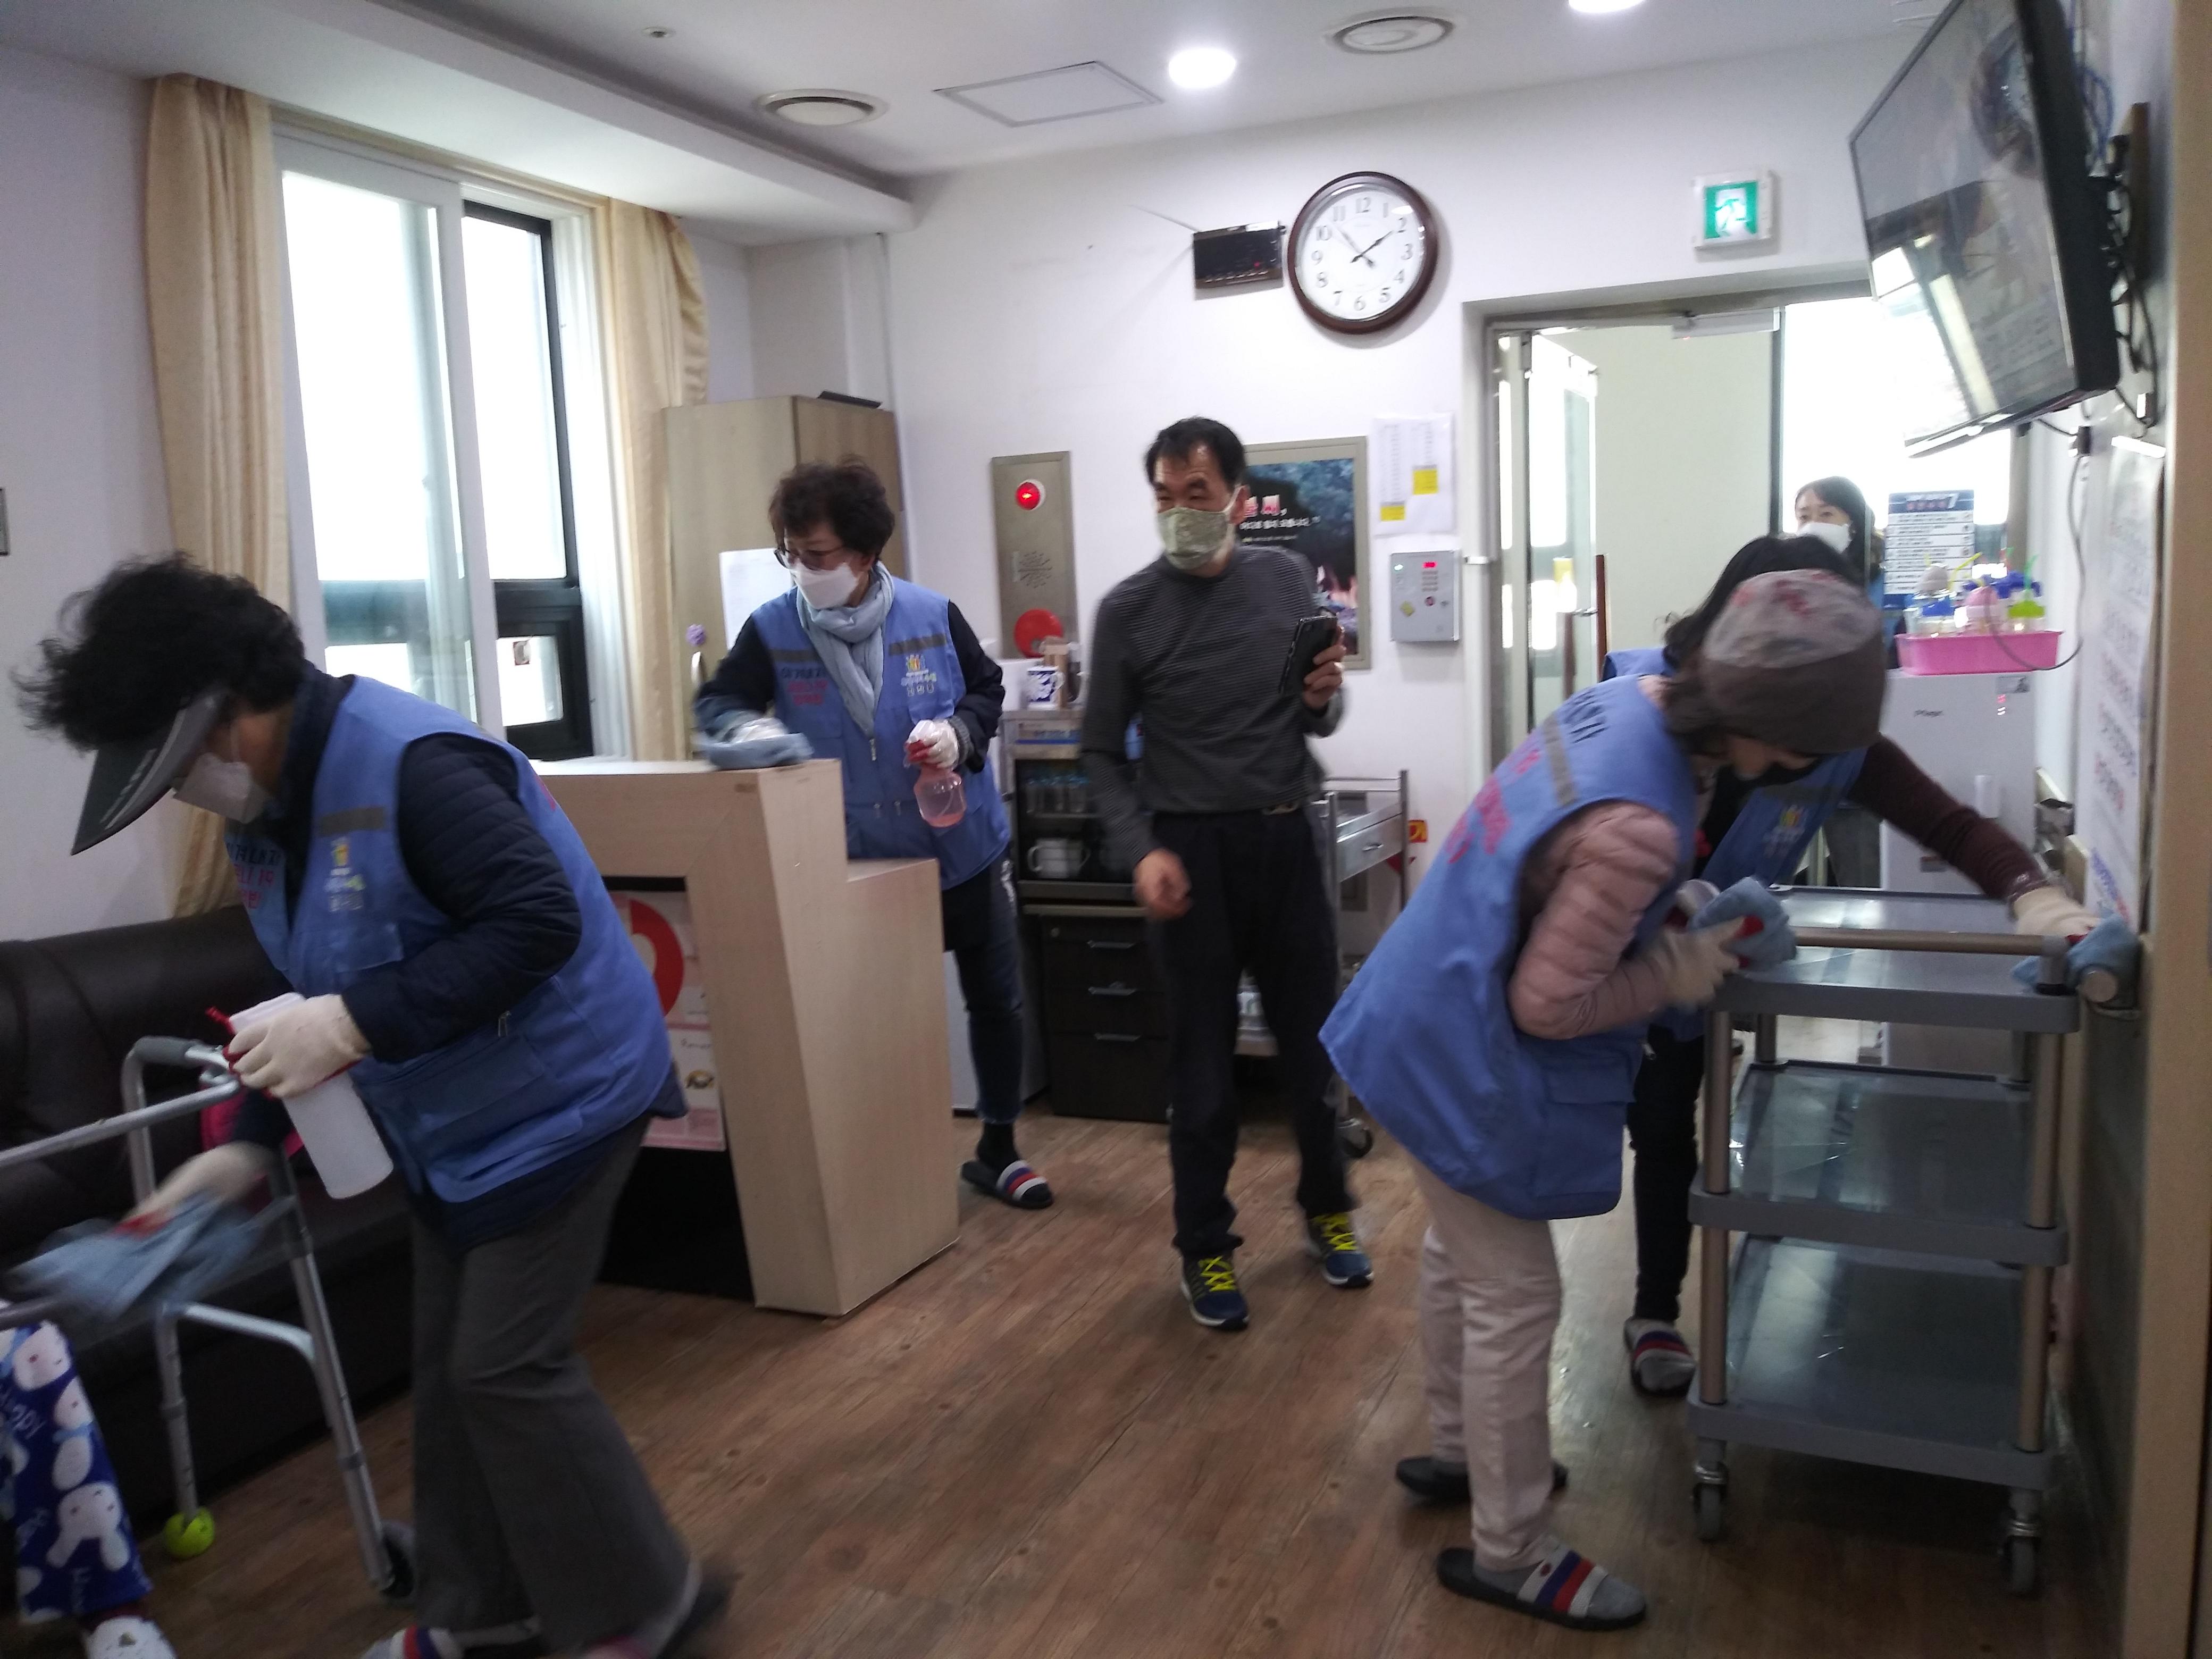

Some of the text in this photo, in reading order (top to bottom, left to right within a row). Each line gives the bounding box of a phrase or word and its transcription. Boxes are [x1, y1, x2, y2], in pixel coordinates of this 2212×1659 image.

[1356, 197, 1371, 213] 12
[1382, 203, 1388, 218] 1
[1333, 206, 1346, 222] 11
[1316, 225, 1331, 240] 10
[1397, 217, 1407, 233] 2
[1311, 250, 1323, 265] 9
[1401, 244, 1413, 260] 3
[1316, 272, 1328, 288] 8
[1393, 269, 1404, 283] 4
[1333, 290, 1343, 306] 7
[1379, 287, 1391, 303] 5
[1354, 296, 1366, 311] 6
